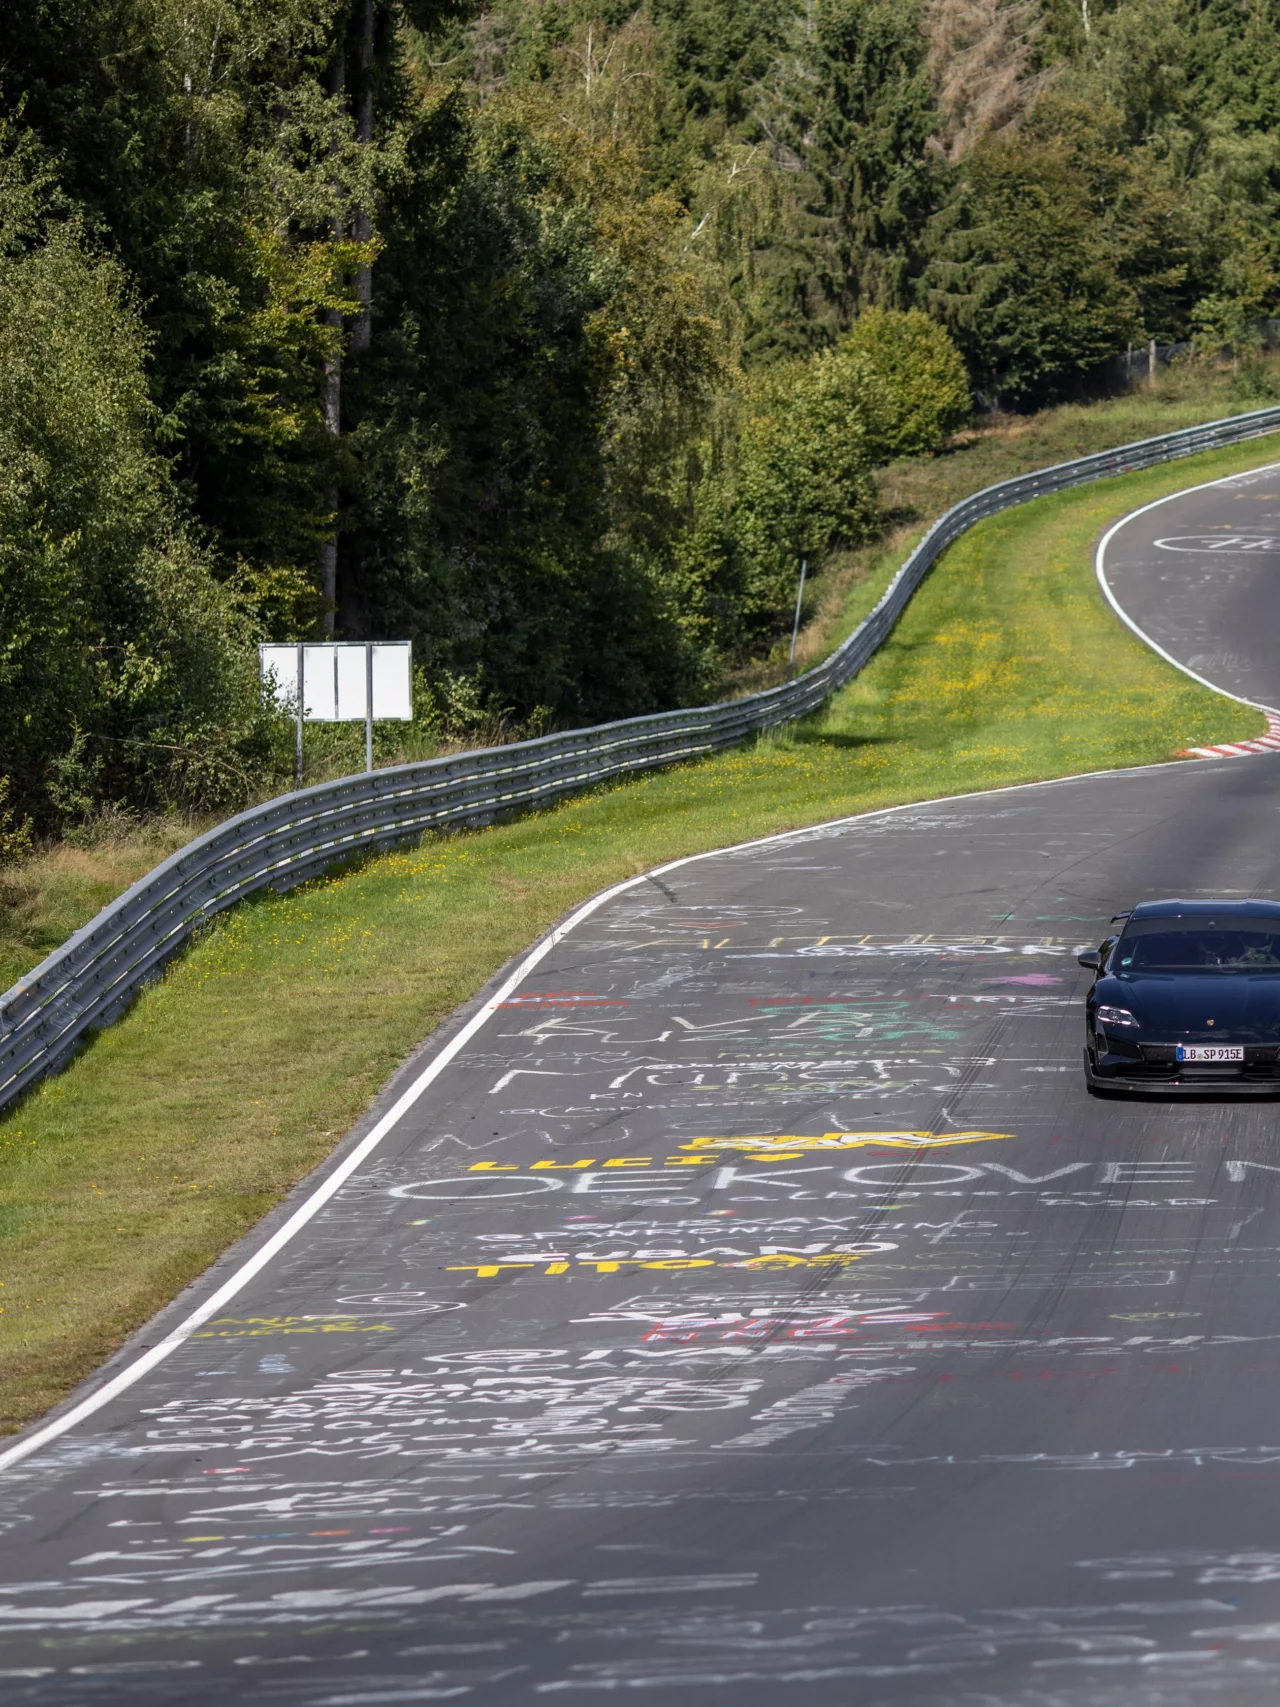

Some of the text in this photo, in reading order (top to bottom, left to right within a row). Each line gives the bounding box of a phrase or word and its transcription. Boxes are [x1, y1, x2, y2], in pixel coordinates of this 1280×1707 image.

[1204, 1049, 1216, 1060] SP
[1218, 1048, 1242, 1060] 915E
[497, 1242, 901, 1262] CUBANO
[446, 1259, 716, 1278] TITO
